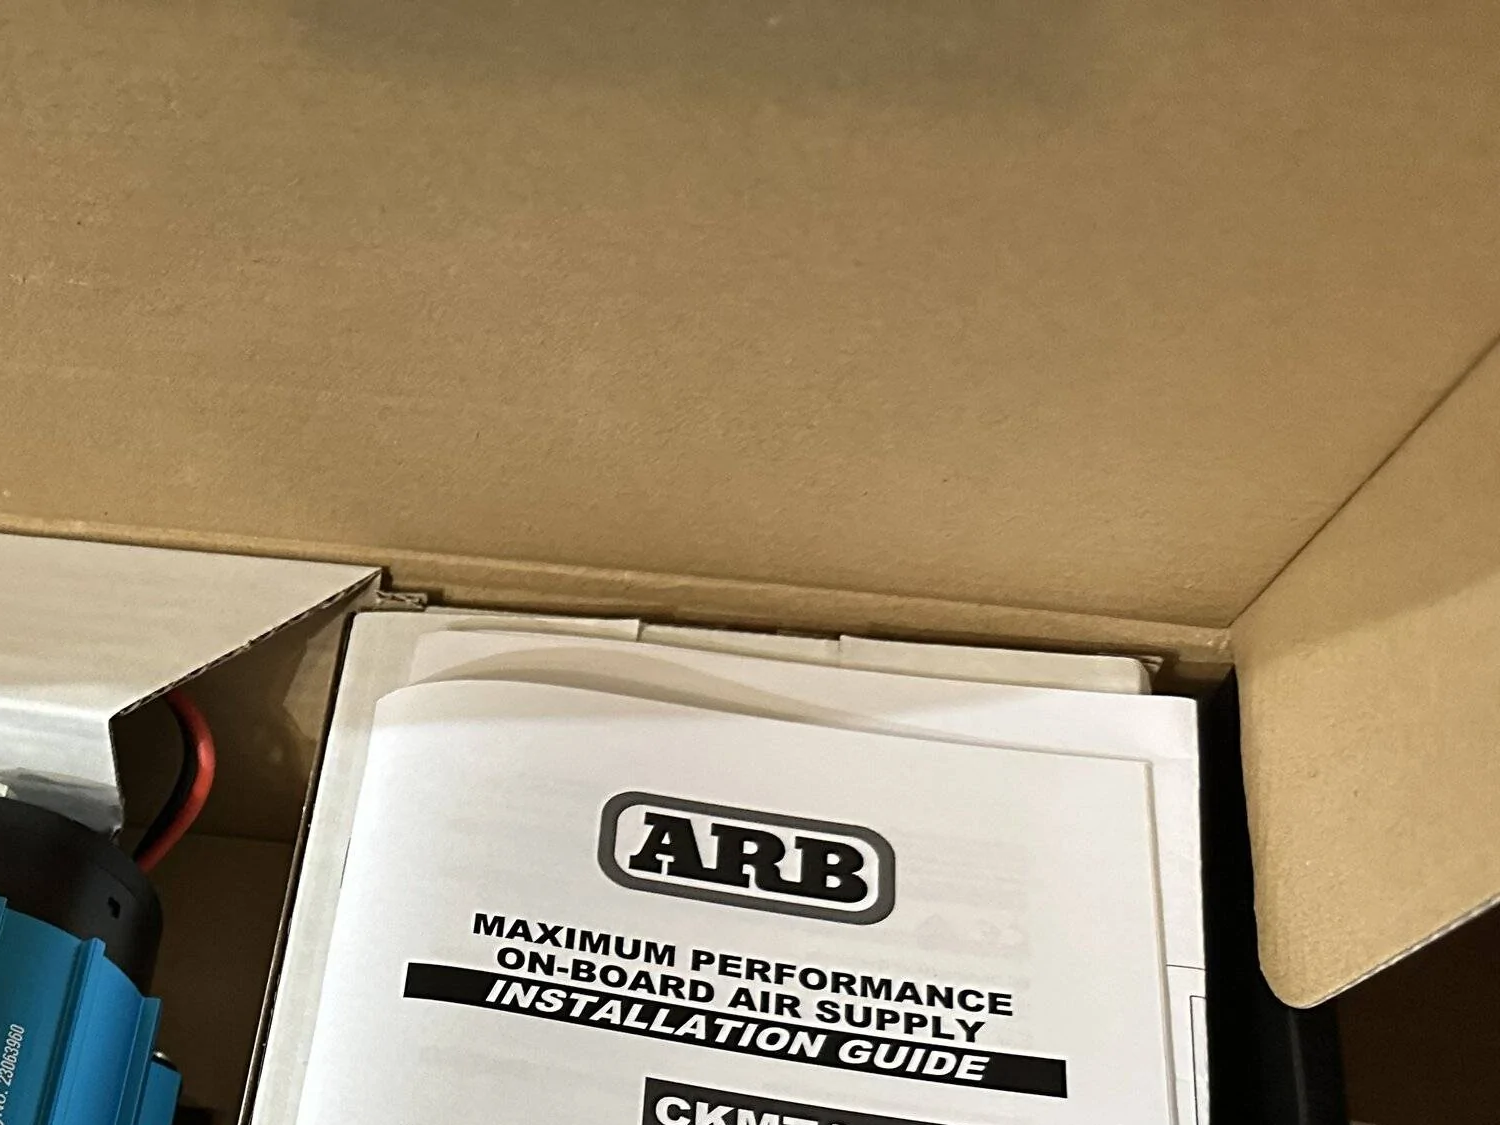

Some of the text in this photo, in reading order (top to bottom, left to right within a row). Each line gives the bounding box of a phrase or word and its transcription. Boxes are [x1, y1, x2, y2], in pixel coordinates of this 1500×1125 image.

[628, 811, 869, 903] ARB
[472, 912, 1013, 1016] MAXIMUM PERFORMANCE
[497, 946, 986, 1044] ON-BOARD AIR SUPPLY
[485, 979, 990, 1082] INSTALLATION GUIDE
